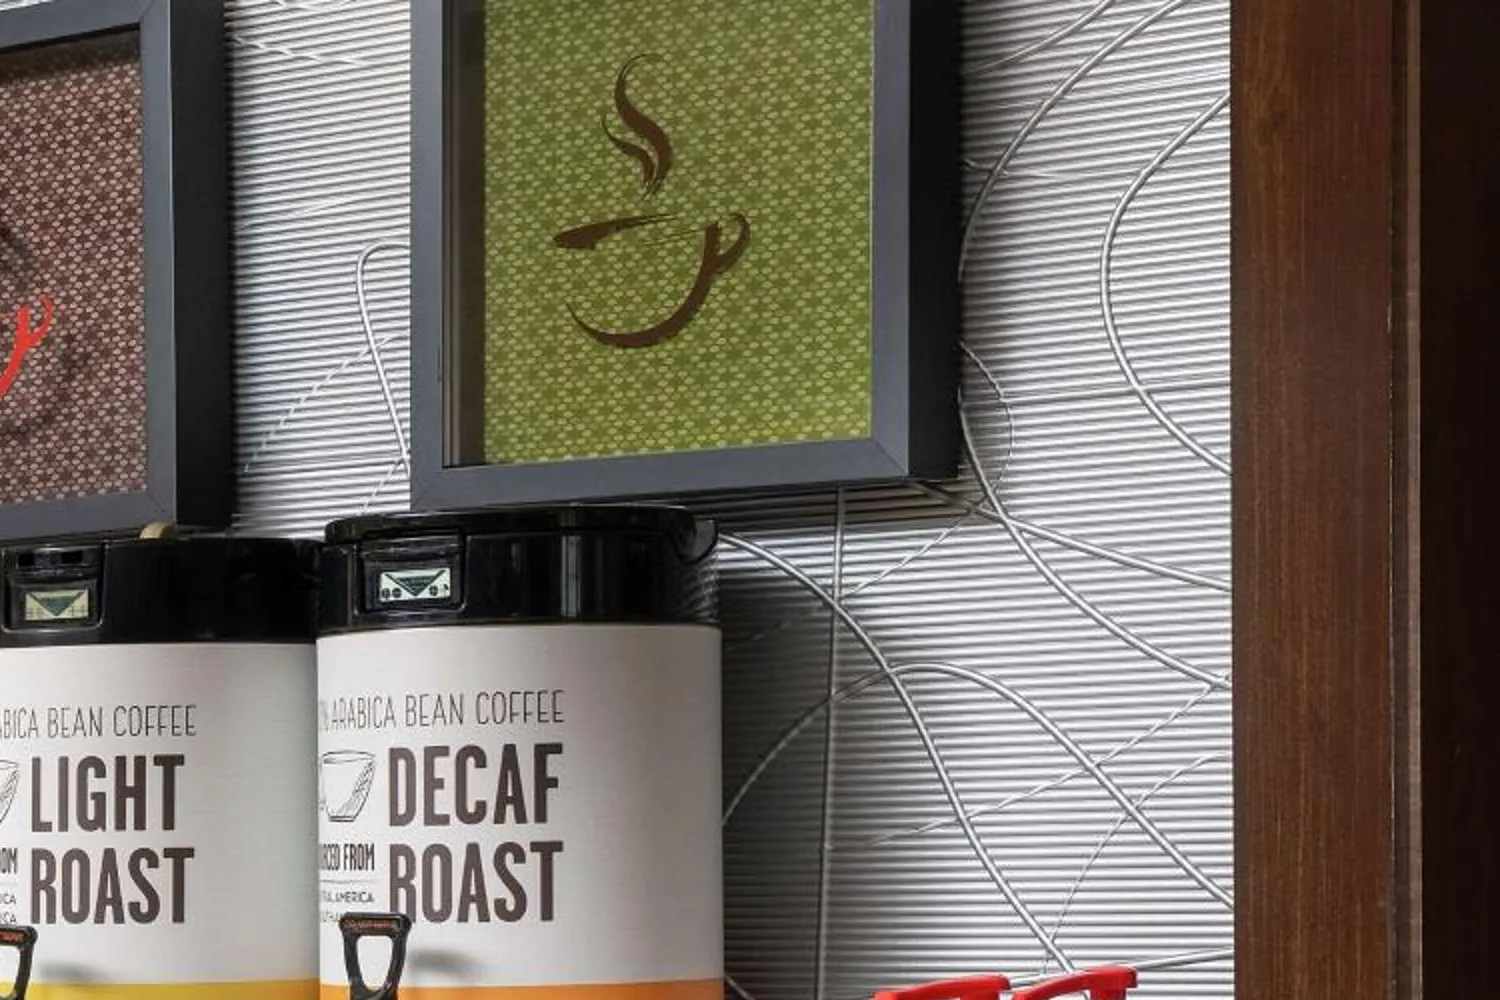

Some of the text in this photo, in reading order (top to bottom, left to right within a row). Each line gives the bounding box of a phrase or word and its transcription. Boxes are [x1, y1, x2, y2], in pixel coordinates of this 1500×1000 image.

[47, 706, 103, 739] BEAN
[113, 704, 197, 737] COFFEE
[331, 696, 396, 729] ARABICA
[405, 693, 464, 727] BEAN
[475, 689, 565, 725] COFFEE
[31, 754, 185, 833] LIGHT
[388, 742, 563, 827] DECAF
[31, 847, 195, 925] ROAST
[343, 843, 375, 871] FROM
[389, 840, 564, 924] ROAST
